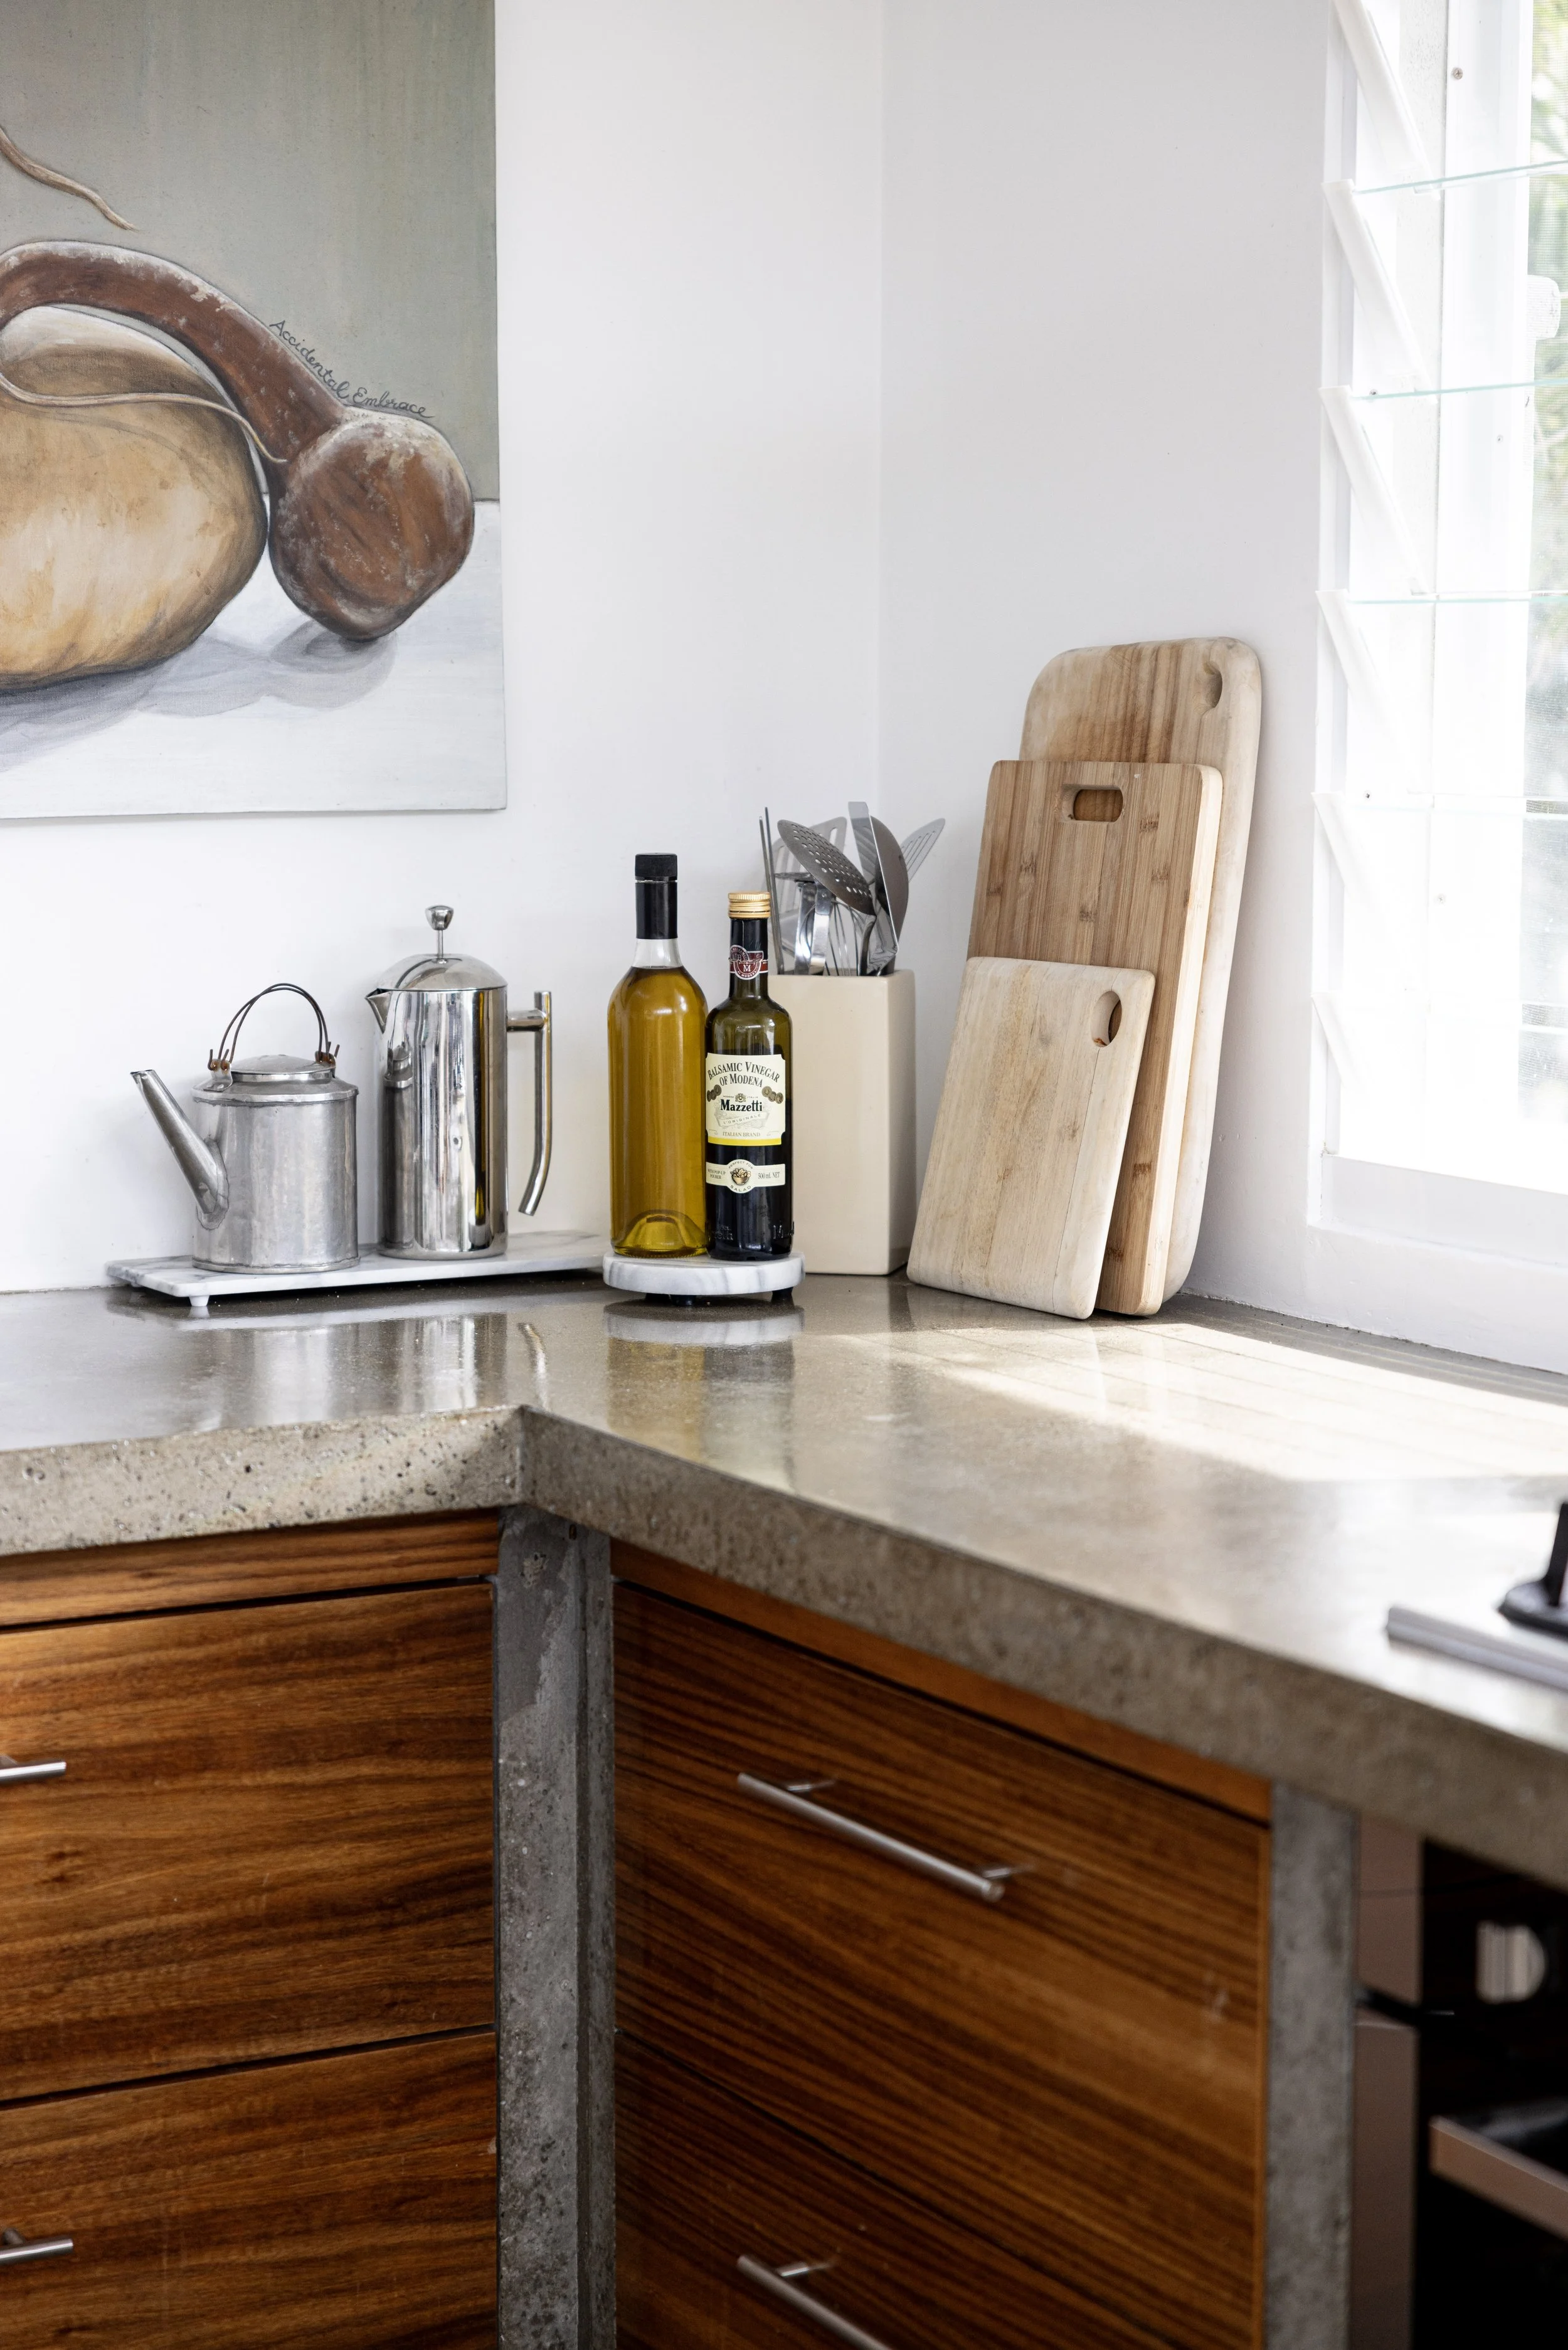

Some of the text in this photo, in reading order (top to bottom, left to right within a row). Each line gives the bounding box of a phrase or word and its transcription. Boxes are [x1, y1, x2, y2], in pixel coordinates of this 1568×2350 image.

[269, 320, 435, 418] Accidental Embrace
[743, 964, 751, 972] M
[707, 1062, 780, 1082] BALSAMIC VINEGAR
[719, 1073, 763, 1088] OF MODENA
[720, 1099, 763, 1111] Mazzetti
[723, 1114, 761, 1124] L'ORIGINALE
[729, 1161, 744, 1169] PERFECT
